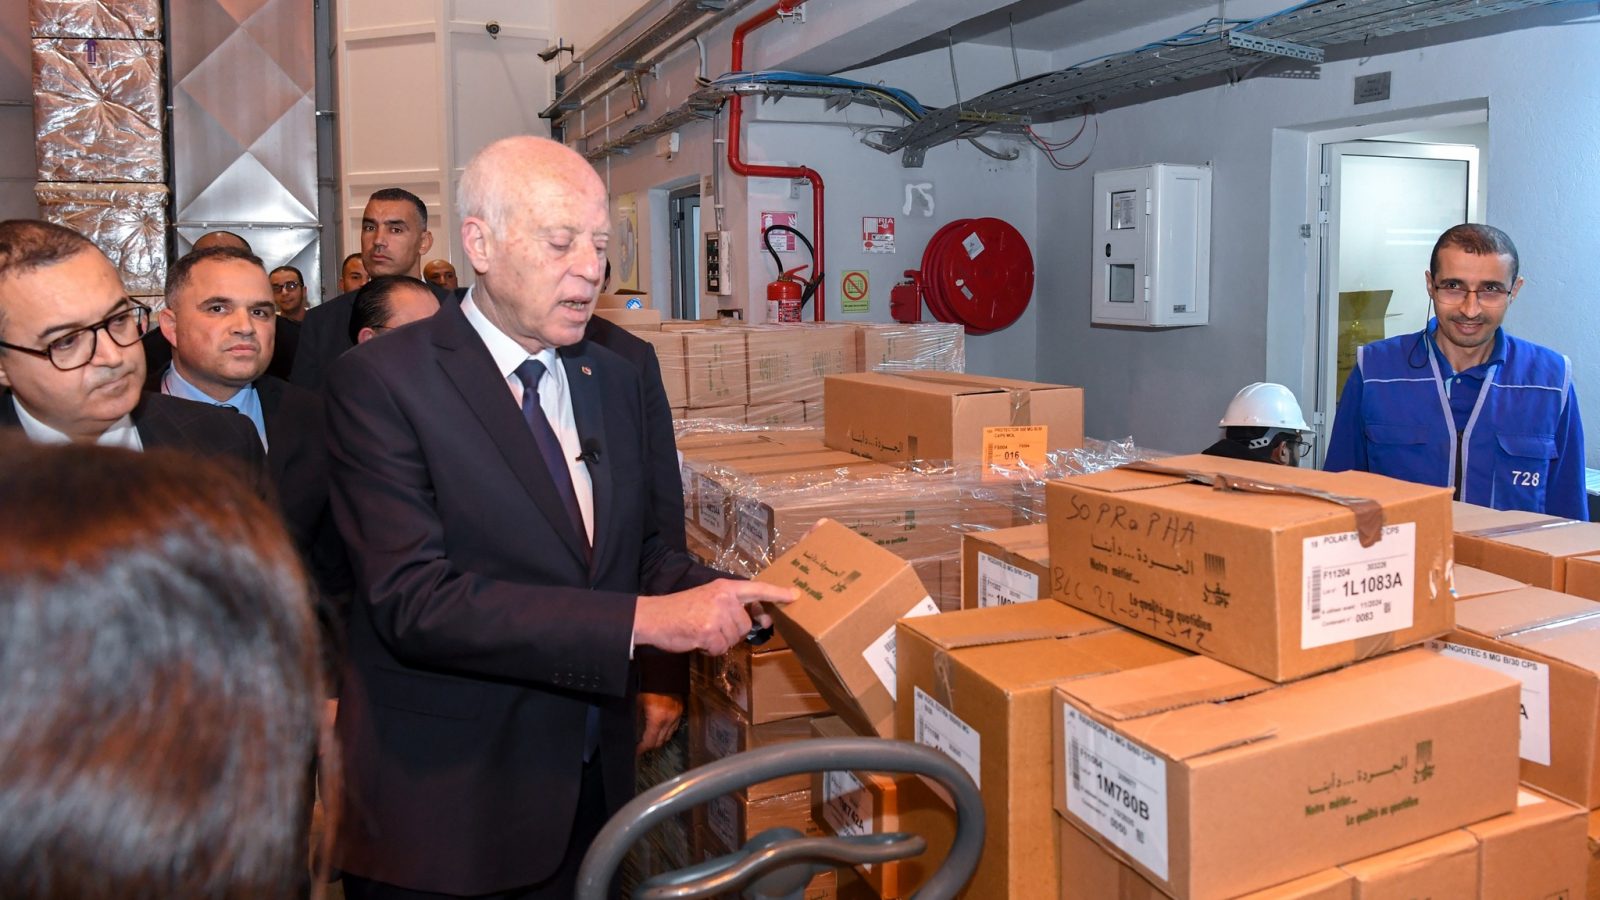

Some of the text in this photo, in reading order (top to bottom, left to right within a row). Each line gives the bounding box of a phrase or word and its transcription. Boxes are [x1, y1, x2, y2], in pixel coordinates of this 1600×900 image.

[1004, 451, 1020, 460] 016
[1512, 470, 1540, 486] 728
[1323, 533, 1348, 545] POLAR
[1385, 526, 1400, 535] CPS
[1342, 571, 1403, 597] 1L1083A
[1175, 611, 1213, 632] quotidien
[1443, 643, 1481, 658] ANGIOTEC
[1489, 653, 1502, 663] MG
[1503, 656, 1520, 667] B/30
[1521, 661, 1538, 671] CPS
[1114, 736, 1126, 748] MG
[1142, 751, 1157, 766] CPS
[1096, 773, 1150, 821] 1M780B
[1389, 796, 1419, 815] quotidien
